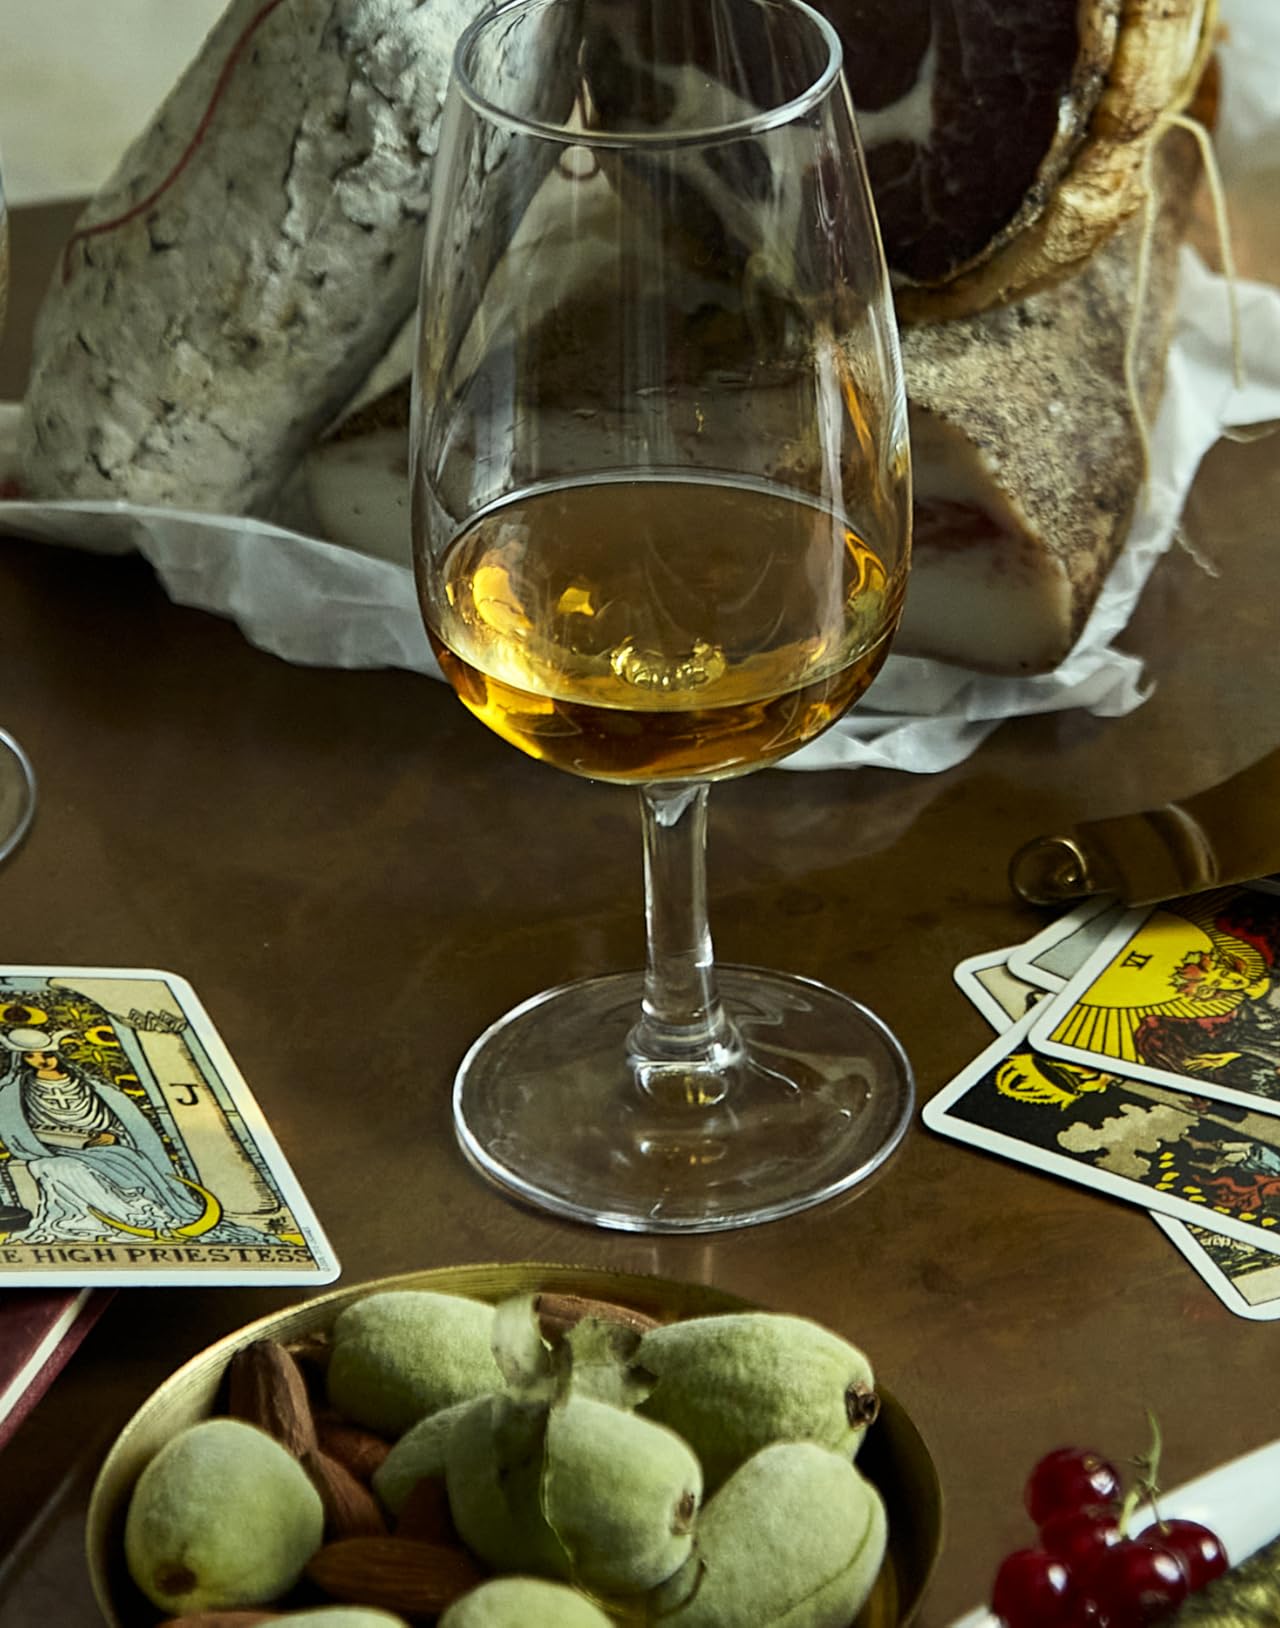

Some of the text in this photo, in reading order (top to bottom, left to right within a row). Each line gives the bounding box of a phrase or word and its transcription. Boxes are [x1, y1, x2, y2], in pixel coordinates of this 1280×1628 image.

[169, 1083, 199, 1106] J
[30, 1248, 116, 1264] HIGH
[128, 1248, 313, 1263] PRIESTESS
